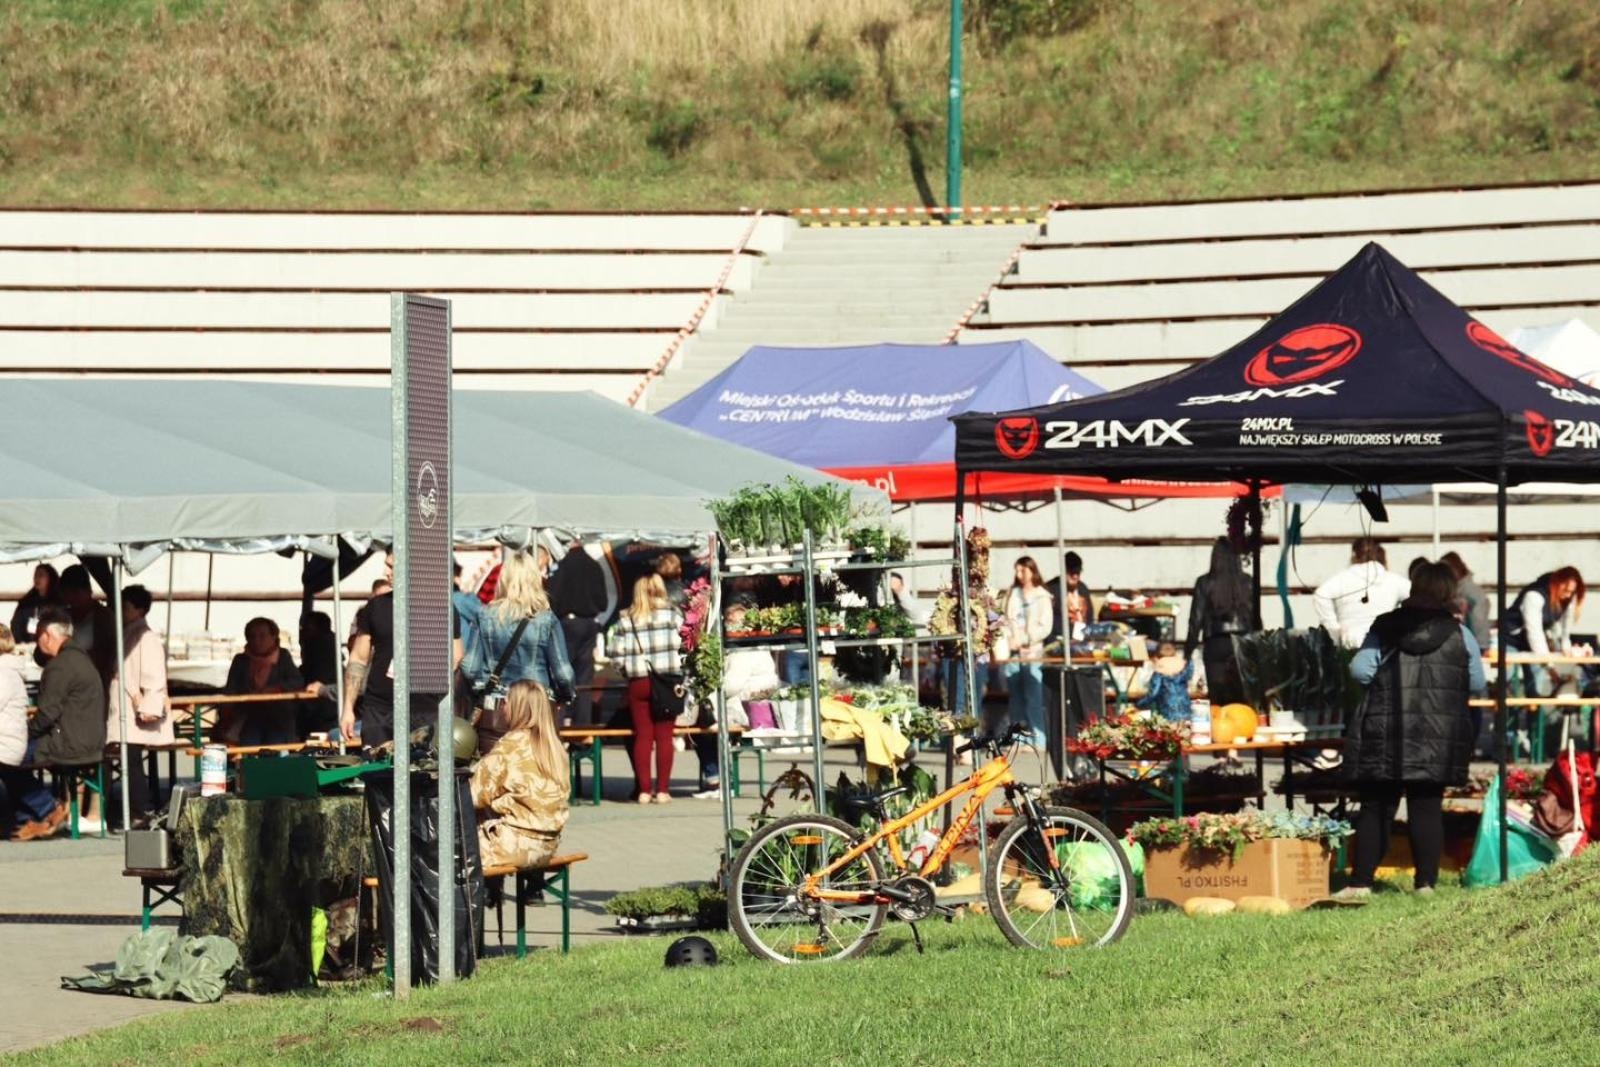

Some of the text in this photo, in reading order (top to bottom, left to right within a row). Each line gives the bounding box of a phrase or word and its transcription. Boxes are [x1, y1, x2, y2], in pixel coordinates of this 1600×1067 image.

[842, 388, 896, 407] Sportu
[1240, 416, 1294, 432] 24MX.PL
[1045, 417, 1193, 449] 24MX
[1239, 432, 1443, 448] NAJWIĘKSZY SKLEP MOTOCROSS W POLSCE
